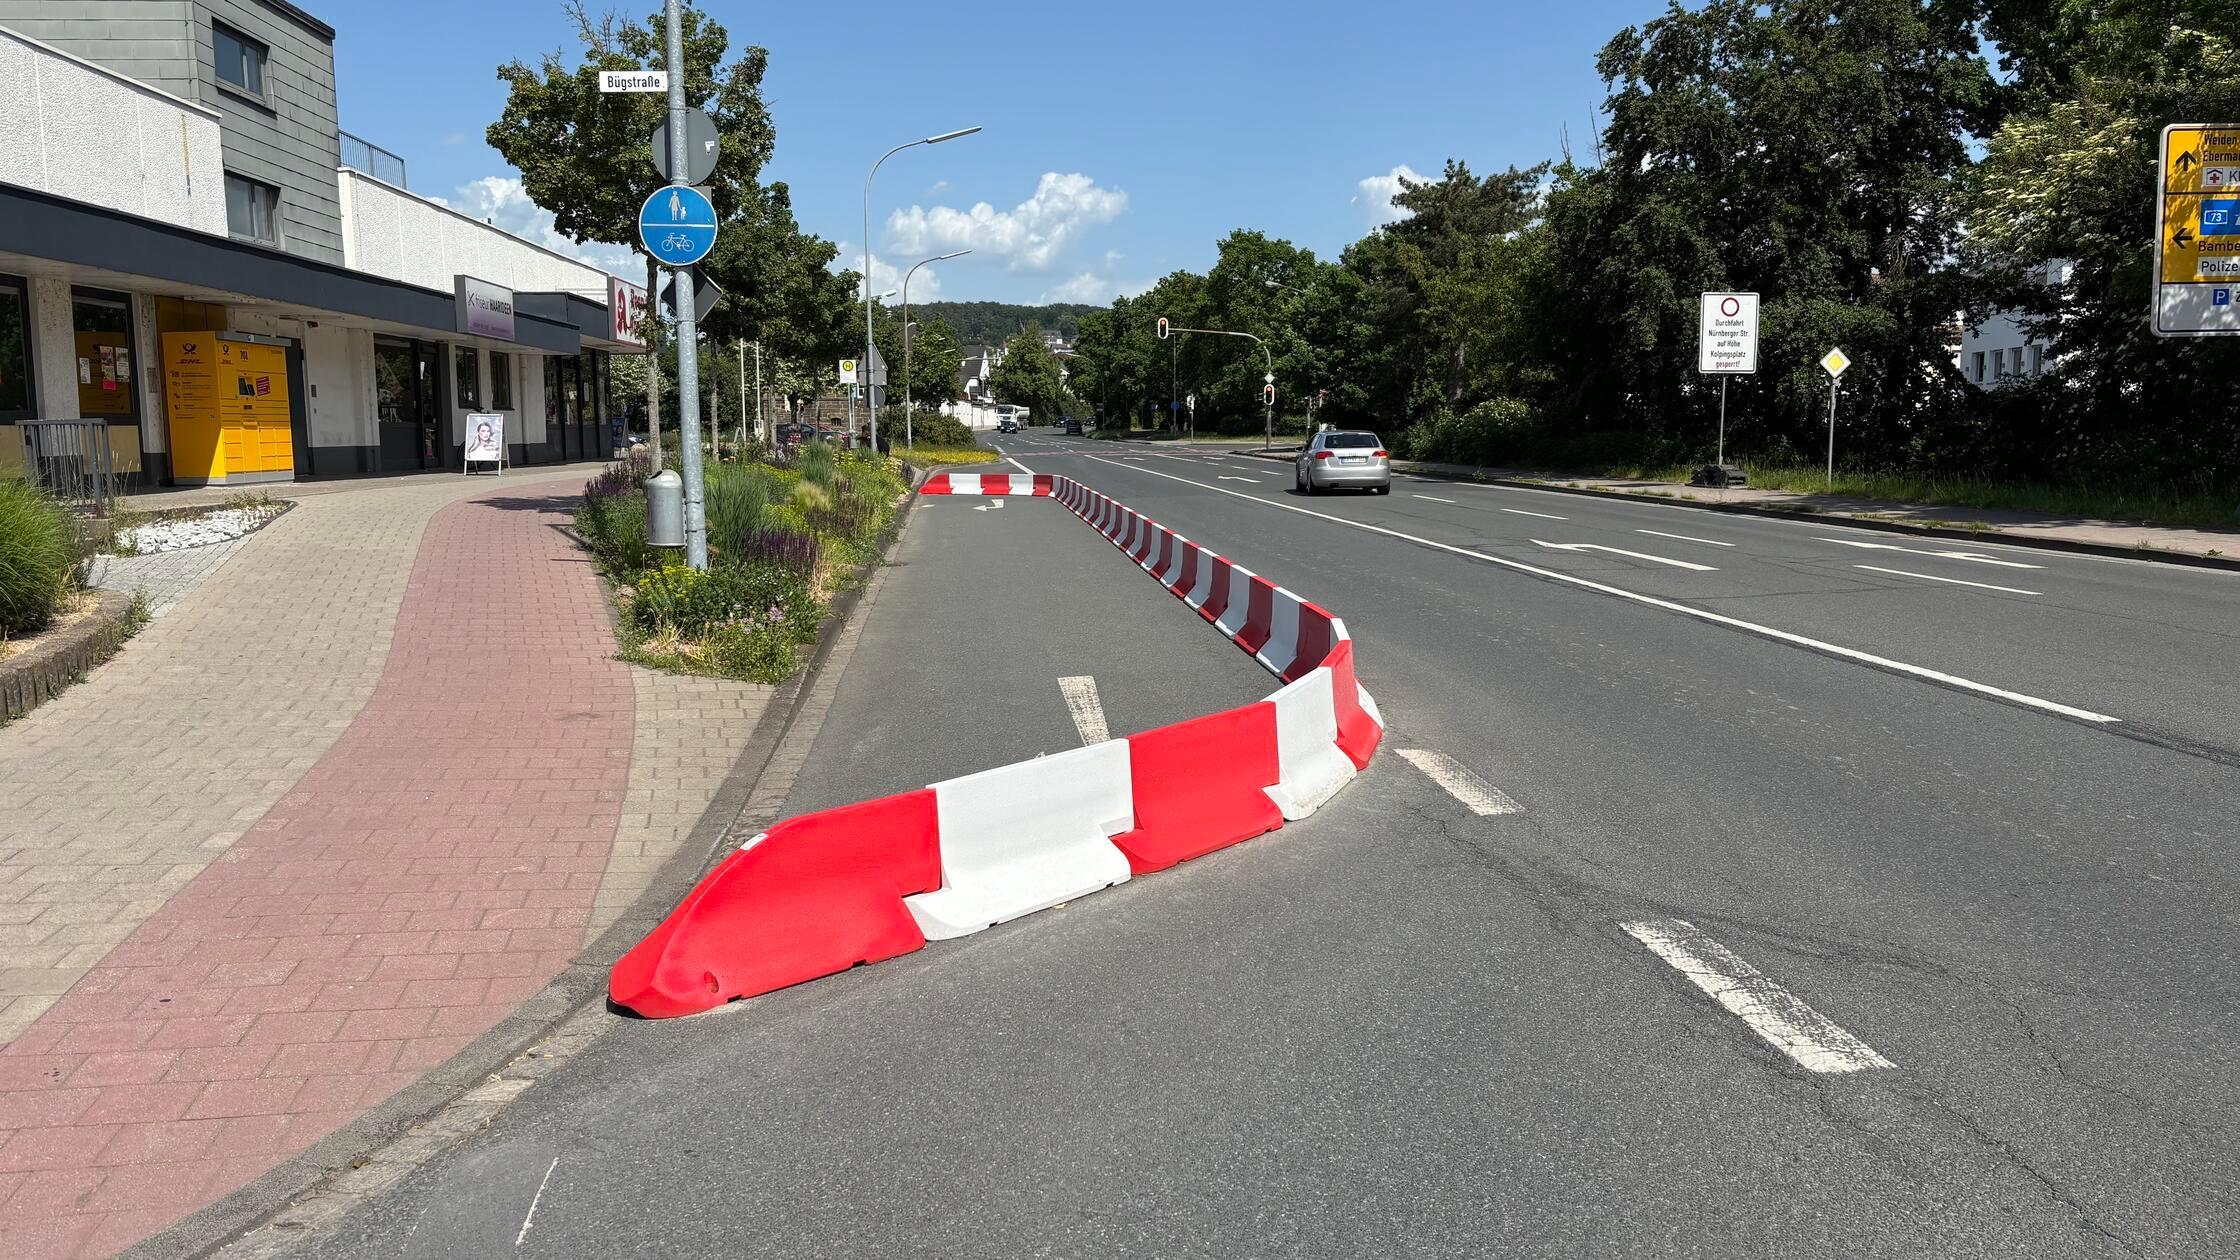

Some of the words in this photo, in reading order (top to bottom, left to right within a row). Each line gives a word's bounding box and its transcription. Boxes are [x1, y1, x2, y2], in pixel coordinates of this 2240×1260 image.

[607, 75, 660, 91] Bügstraße
[2204, 133, 2238, 146] Weiden
[2210, 212, 2222, 222] 73
[1709, 329, 1739, 338] Nürnberger
